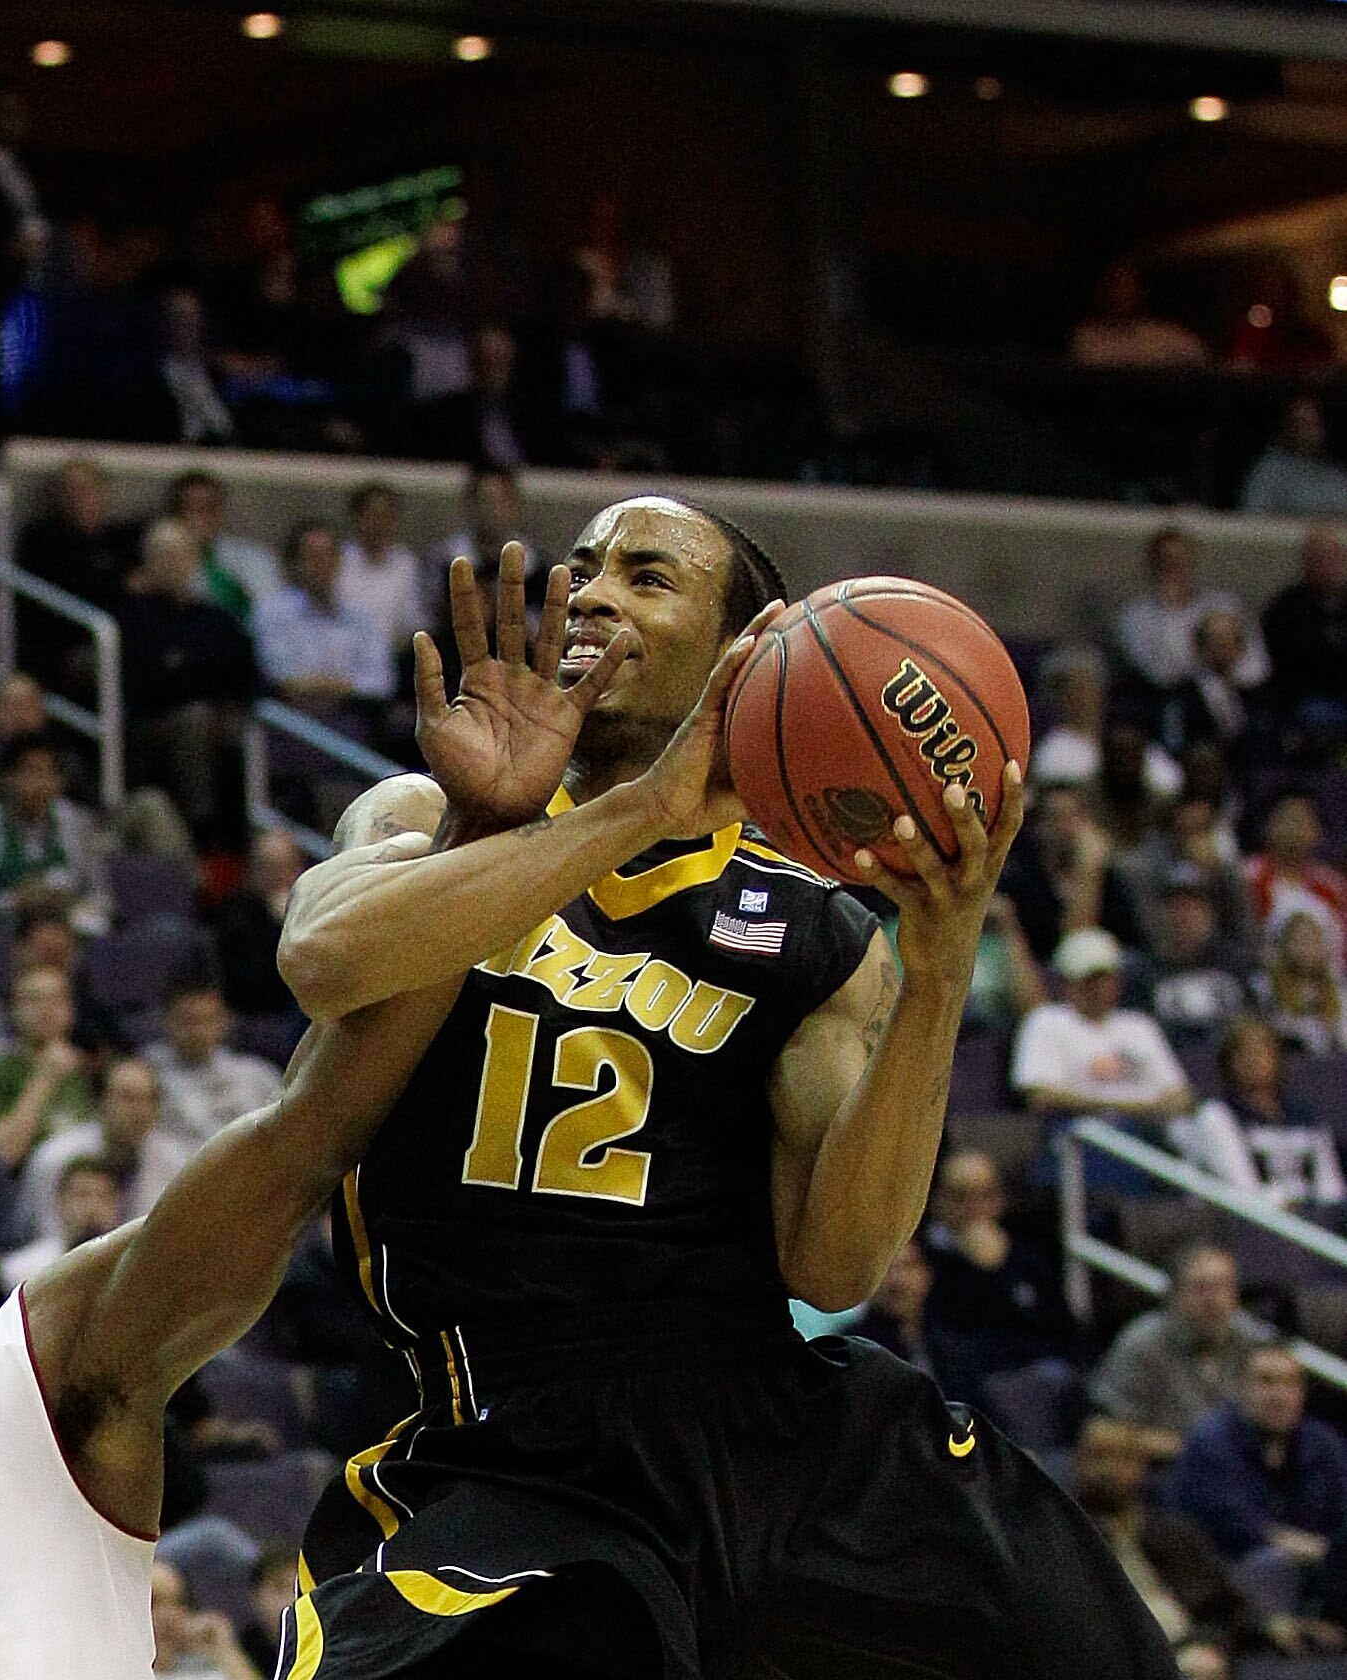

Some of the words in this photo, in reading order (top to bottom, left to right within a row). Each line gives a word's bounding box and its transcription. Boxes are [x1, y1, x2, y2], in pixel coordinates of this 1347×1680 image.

[881, 657, 987, 825] Wil
[473, 914, 757, 1054] IZZOU
[461, 1003, 653, 1206] 12
